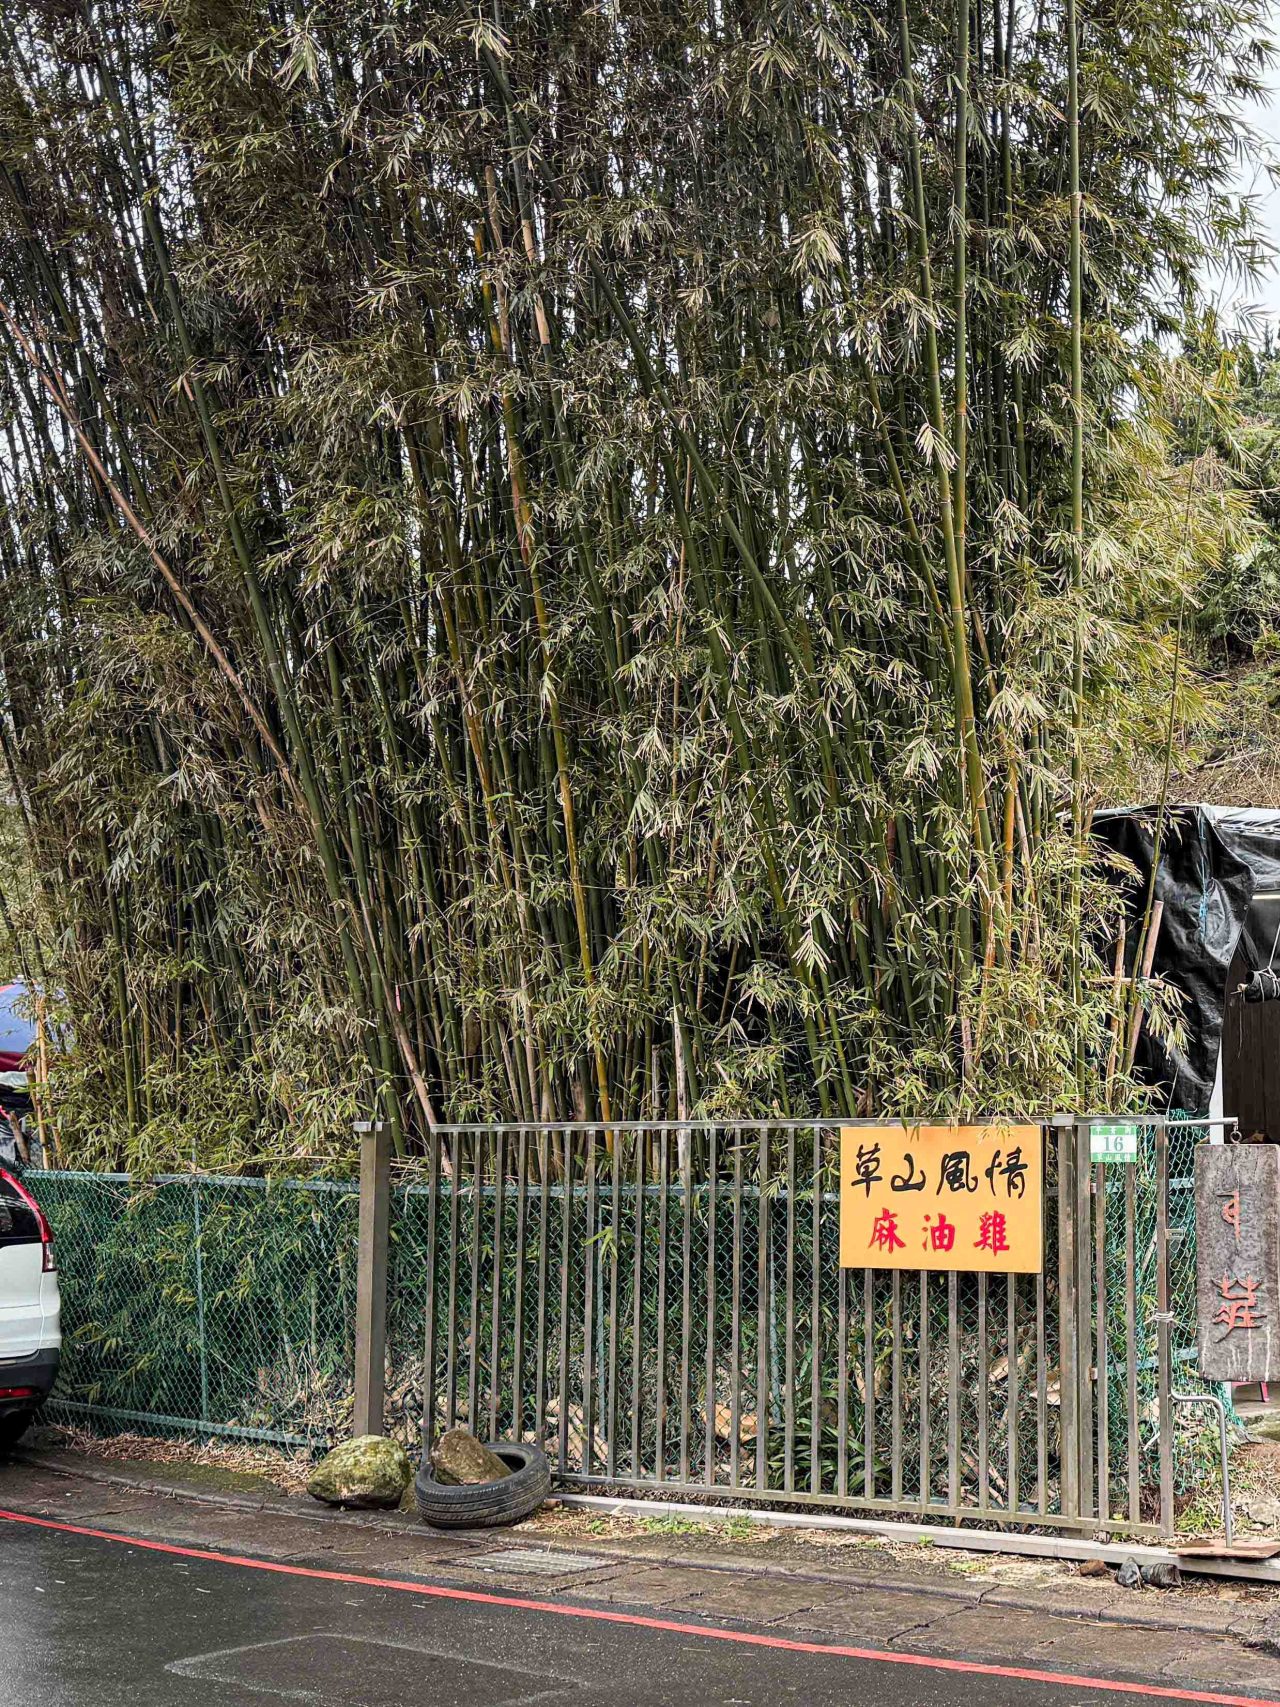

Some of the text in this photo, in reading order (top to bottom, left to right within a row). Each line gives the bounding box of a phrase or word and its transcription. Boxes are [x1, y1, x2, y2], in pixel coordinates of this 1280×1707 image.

[1104, 1136, 1124, 1152] 16
[851, 1142, 1028, 1199] 草山風情
[868, 1207, 1010, 1257] 麻油雞
